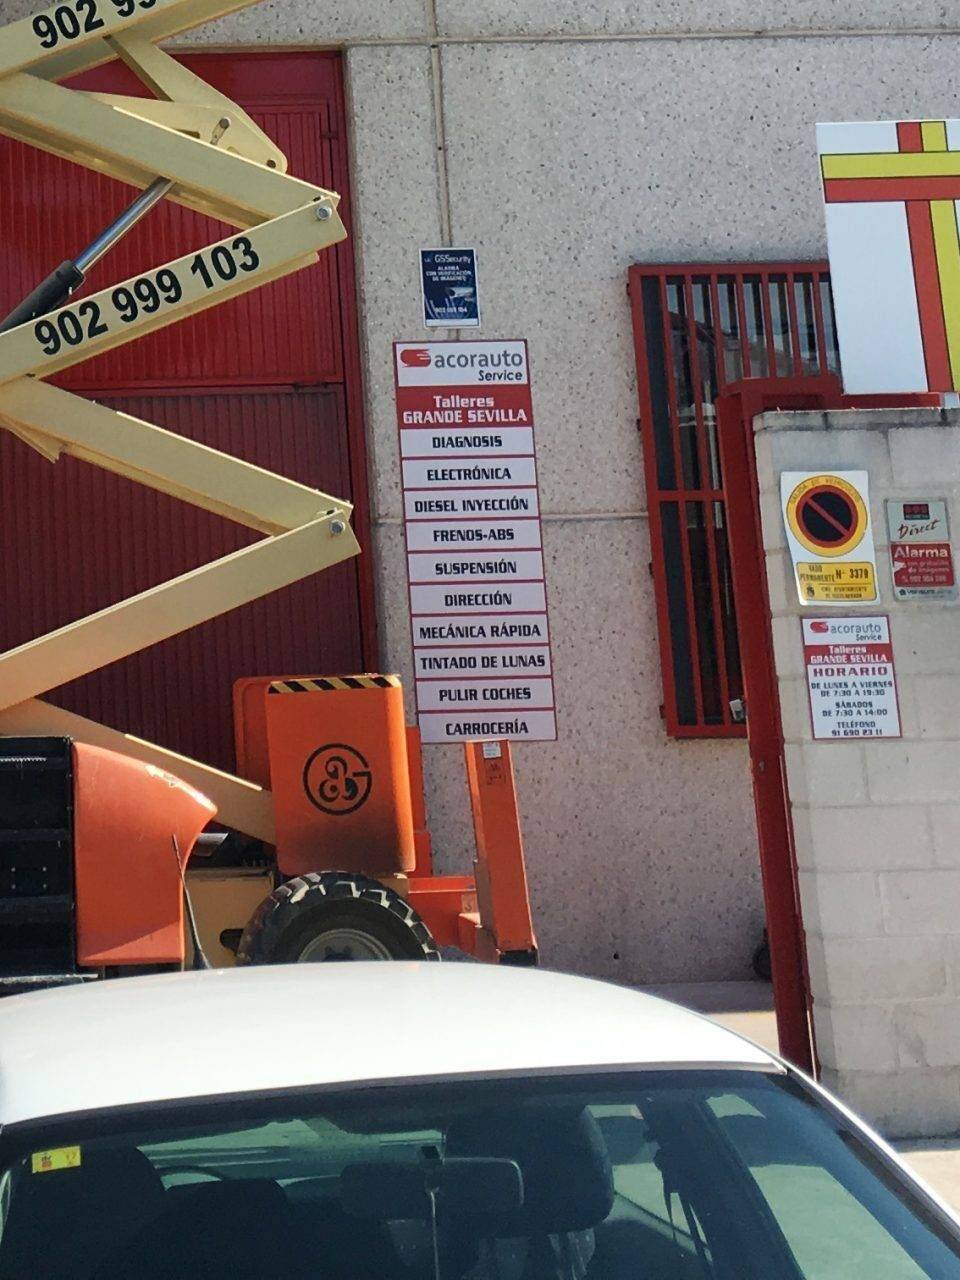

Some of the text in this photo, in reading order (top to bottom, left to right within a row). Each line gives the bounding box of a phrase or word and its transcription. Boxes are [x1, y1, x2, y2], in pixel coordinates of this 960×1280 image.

[32, 0, 105, 50] 902
[34, 303, 108, 356] 902
[112, 270, 183, 323] 999
[190, 236, 261, 290] 103
[434, 350, 523, 368] acorauto
[478, 370, 522, 381] Service
[433, 395, 495, 408] Talleres
[403, 408, 528, 424] GRANDE SEVILLA
[432, 435, 503, 449] DIAGNOSIS
[427, 465, 512, 481] ELECTRÓNICA
[414, 496, 529, 513] DIESEL INYECCIÓN
[433, 528, 514, 542] FRENOS-ABS
[894, 545, 948, 558] Alarma
[435, 559, 517, 575] SUSPENSIÓN
[444, 591, 512, 607] DIRECCIÓN
[419, 621, 541, 639] MECÁNICA RÁPIDA
[831, 623, 882, 634] acorauto
[828, 645, 867, 654] Talleres
[420, 654, 546, 670] TINTADO DE LUNAS
[810, 654, 888, 664] GRANDE SEVILLA
[813, 666, 888, 677] HORARIO
[823, 681, 849, 689] LUNES
[860, 680, 893, 688] VIERNES
[439, 687, 531, 702] PULIR COCHES
[835, 709, 853, 717] 7:30
[865, 708, 888, 716] 14:00
[446, 718, 529, 736] CARROCERÍA
